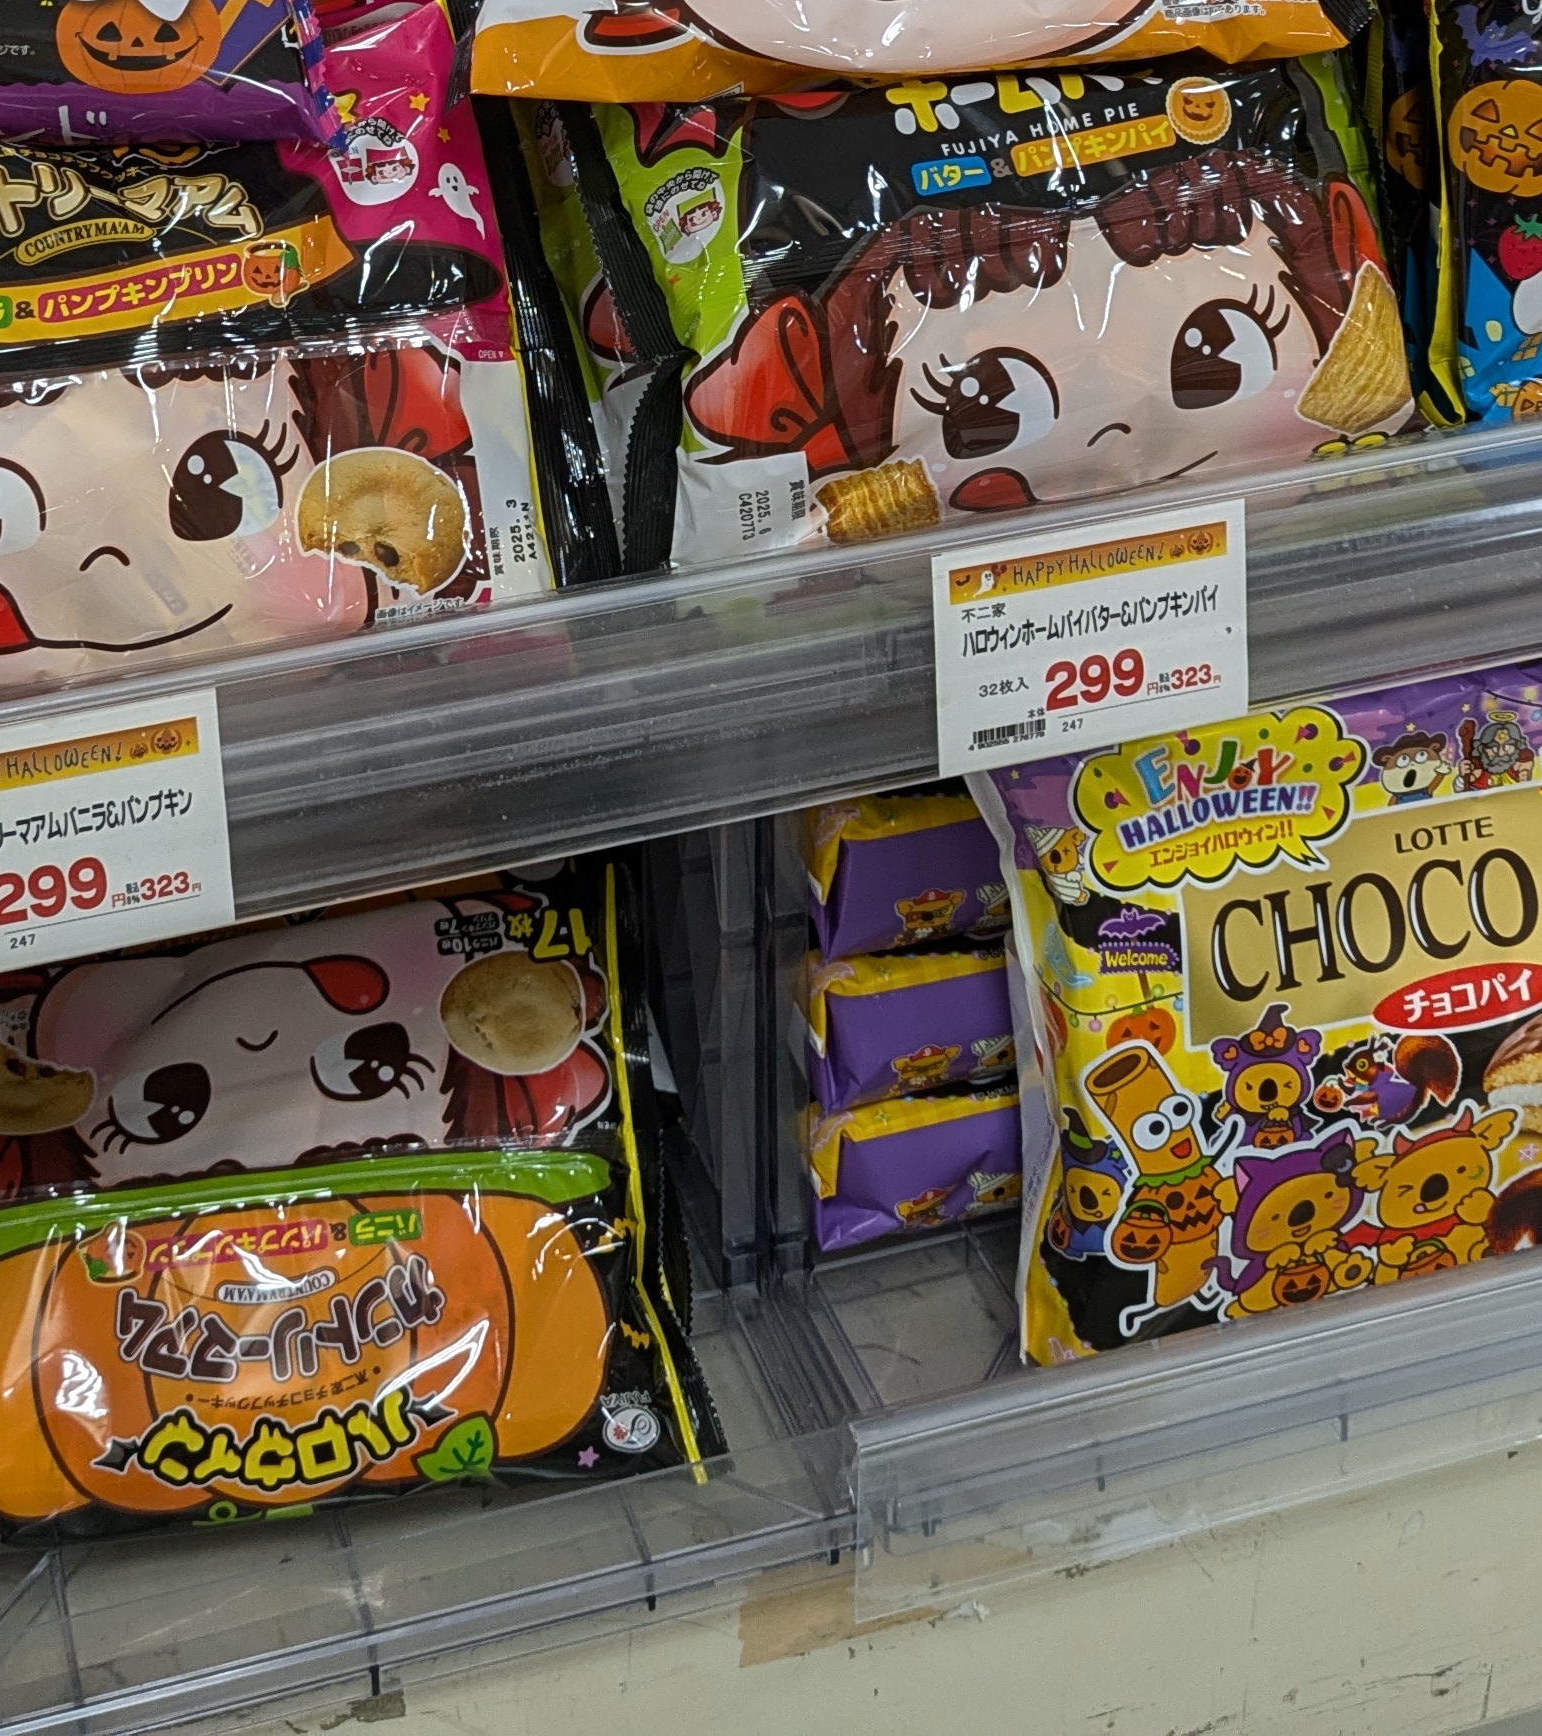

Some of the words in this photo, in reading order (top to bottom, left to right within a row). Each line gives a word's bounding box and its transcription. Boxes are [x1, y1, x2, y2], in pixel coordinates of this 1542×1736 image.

[15, 302, 35, 320] &
[43, 261, 239, 317] パンプキンプリン
[961, 603, 1006, 623] 不二家
[979, 677, 1029, 697] 32枚入
[1118, 781, 1318, 853] HALLOWEEN!!
[1394, 813, 1495, 854] LOTTE
[1104, 944, 1172, 971] Welcome
[1401, 966, 1537, 1023] チョコパイ
